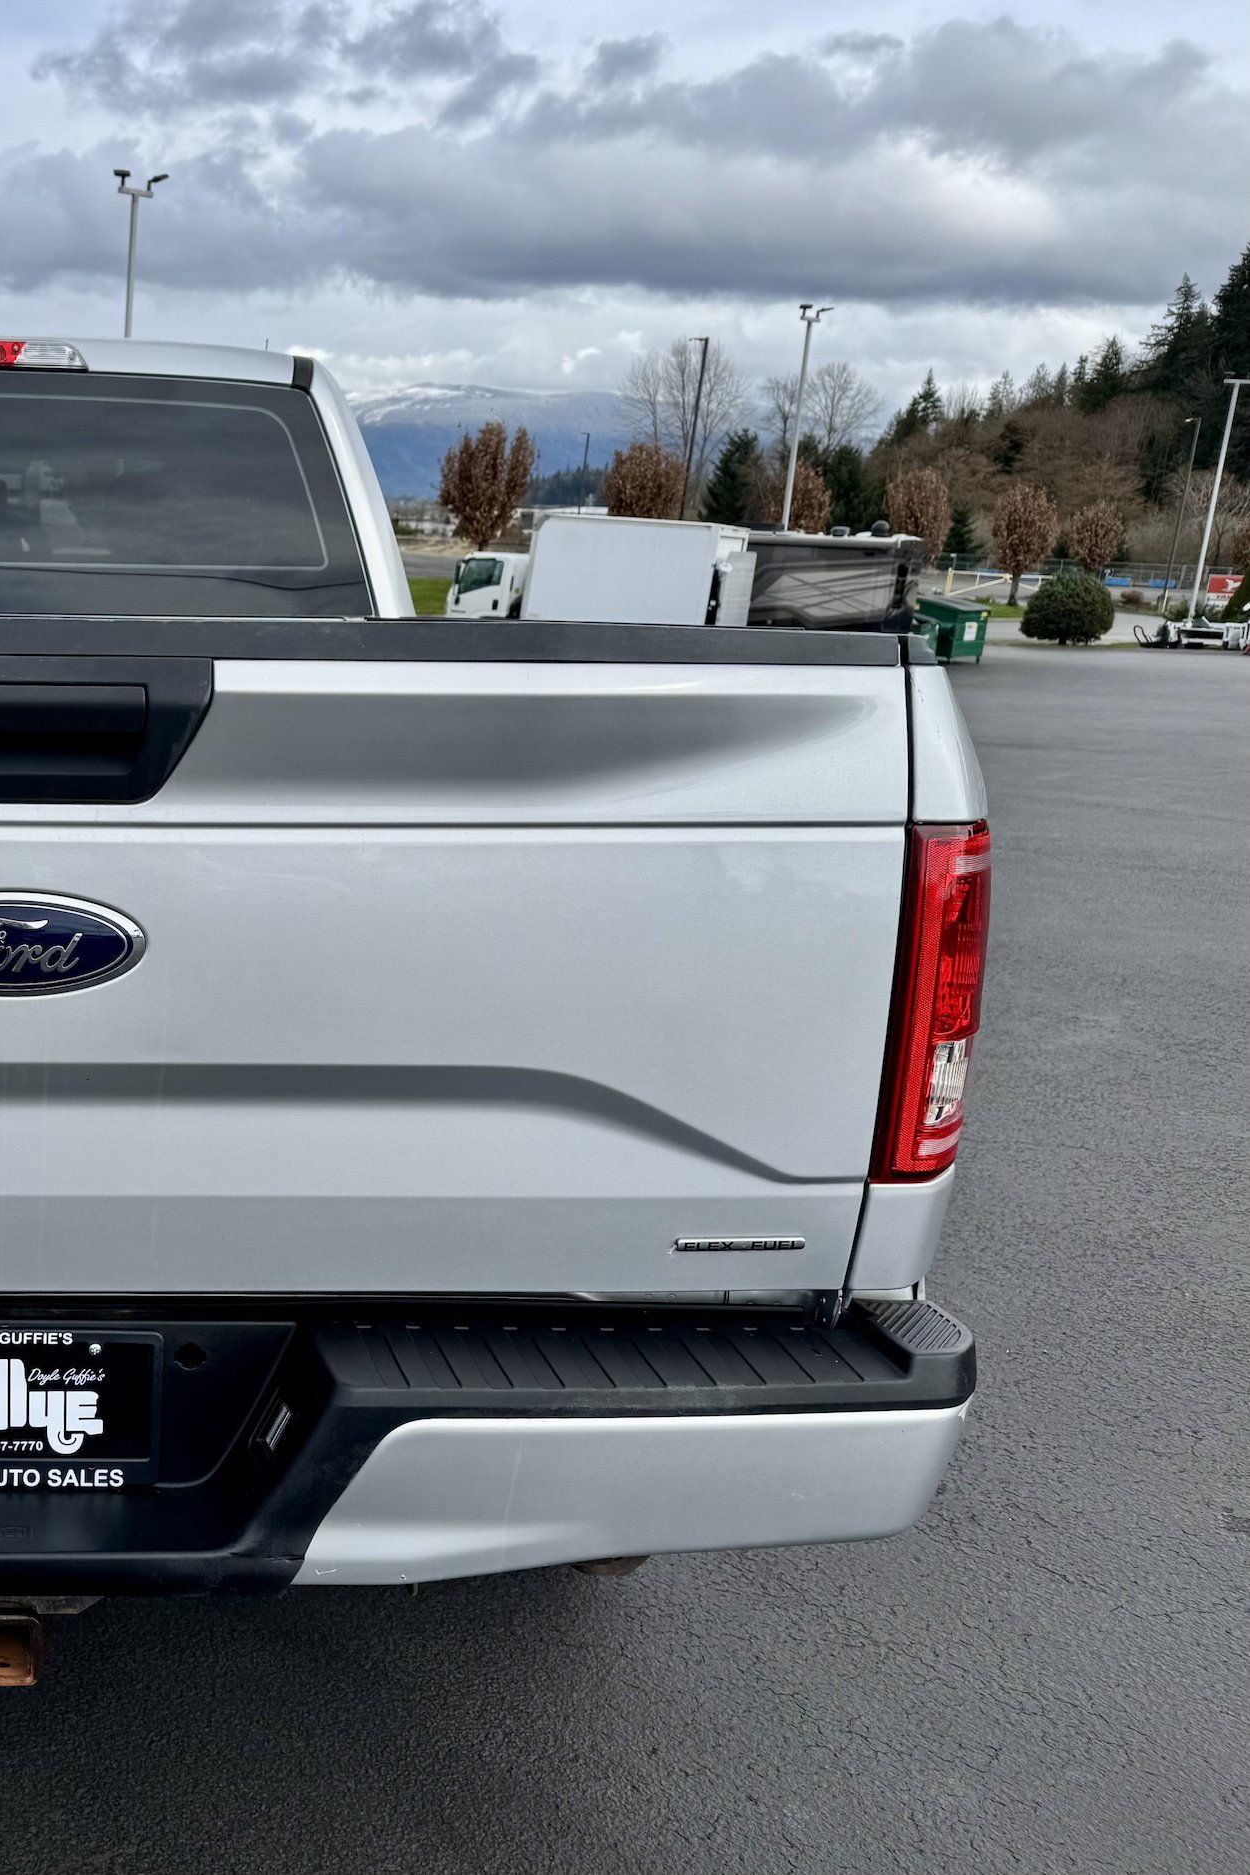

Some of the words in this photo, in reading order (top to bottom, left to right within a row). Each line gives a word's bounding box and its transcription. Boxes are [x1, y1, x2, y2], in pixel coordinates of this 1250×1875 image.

[683, 1241, 735, 1251] FLEX
[750, 1240, 801, 1250] FUEL
[28, 1368, 61, 1386] Doyle
[63, 1368, 106, 1386] Guffie's
[47, 1468, 124, 1487] SALES
